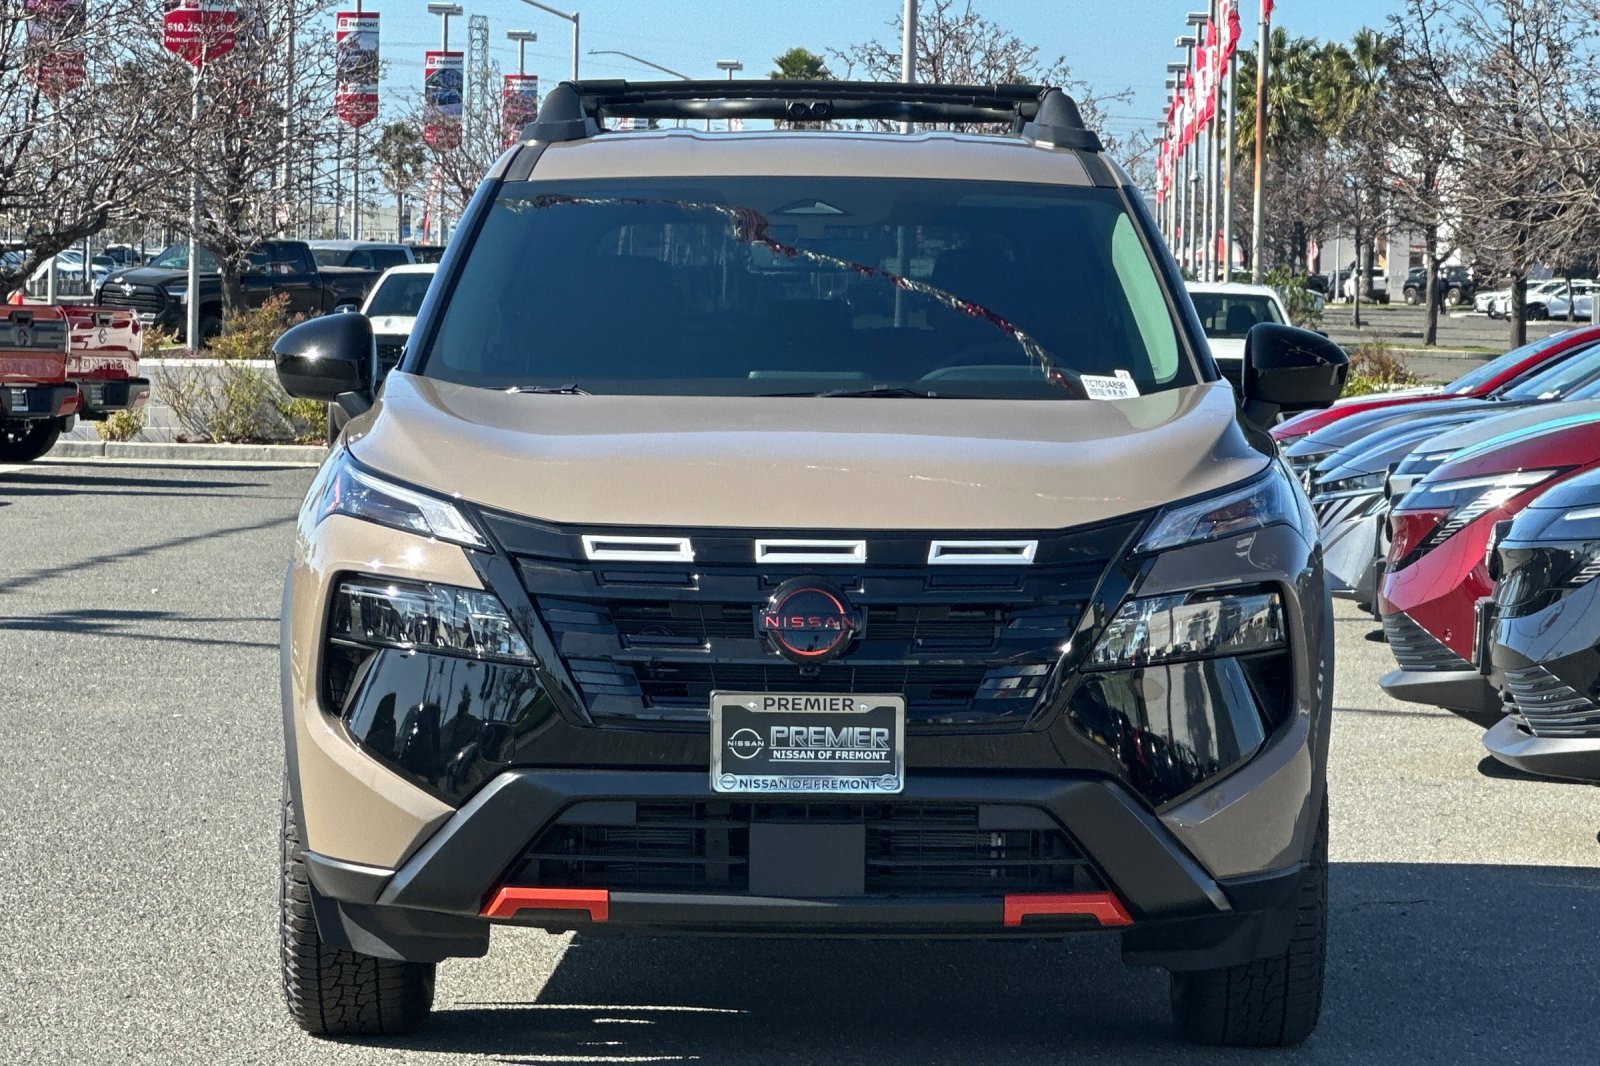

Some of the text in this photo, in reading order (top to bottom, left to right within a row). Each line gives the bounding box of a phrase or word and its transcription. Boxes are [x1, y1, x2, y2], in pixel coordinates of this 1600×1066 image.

[765, 616, 855, 629] NISSAN
[763, 697, 855, 711] PREMIER
[770, 726, 890, 749] PREMIER
[773, 750, 887, 760] NISSAN OF FREMONT
[739, 779, 788, 789] NISSAN
[792, 779, 810, 789] OF
[813, 780, 878, 790] FREMONT
